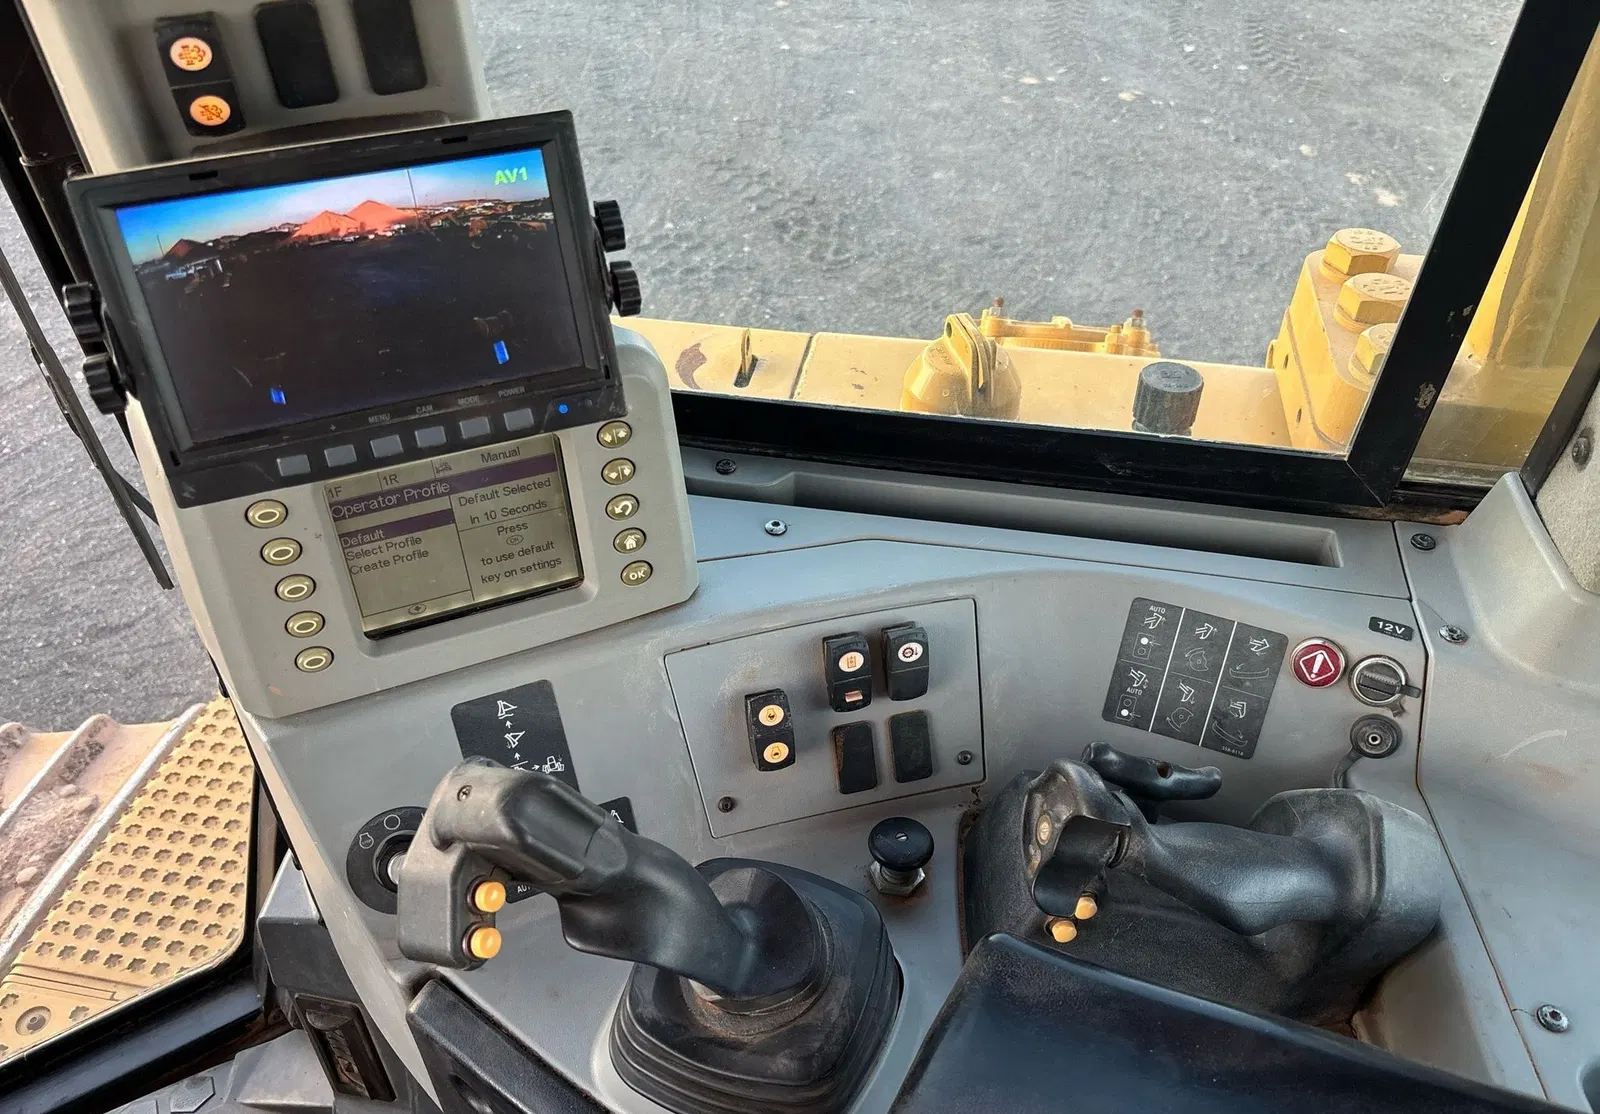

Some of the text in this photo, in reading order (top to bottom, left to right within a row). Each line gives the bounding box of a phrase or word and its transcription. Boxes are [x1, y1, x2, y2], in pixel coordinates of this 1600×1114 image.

[495, 167, 528, 186] AV1
[498, 386, 526, 397] POWER
[457, 395, 481, 405] MODE
[415, 404, 434, 414] CAM
[368, 413, 391, 424] MENU
[481, 446, 521, 463] Manual
[382, 473, 400, 486] 1R
[328, 486, 342, 498] 1F
[458, 477, 551, 507] Default Selected
[331, 482, 450, 519] Operator Profile
[469, 500, 548, 524] In 10 Seconds
[497, 522, 528, 536] Press
[341, 529, 385, 547] Default
[346, 536, 422, 561] Select Profile
[481, 541, 555, 566] to use default
[350, 550, 429, 575] Create Profile
[481, 557, 562, 583] key on settings
[629, 569, 646, 581] OK
[1149, 605, 1166, 614] AUTO
[1377, 621, 1406, 634] 12V
[1126, 686, 1143, 696] AUTO
[517, 884, 531, 894] AU
